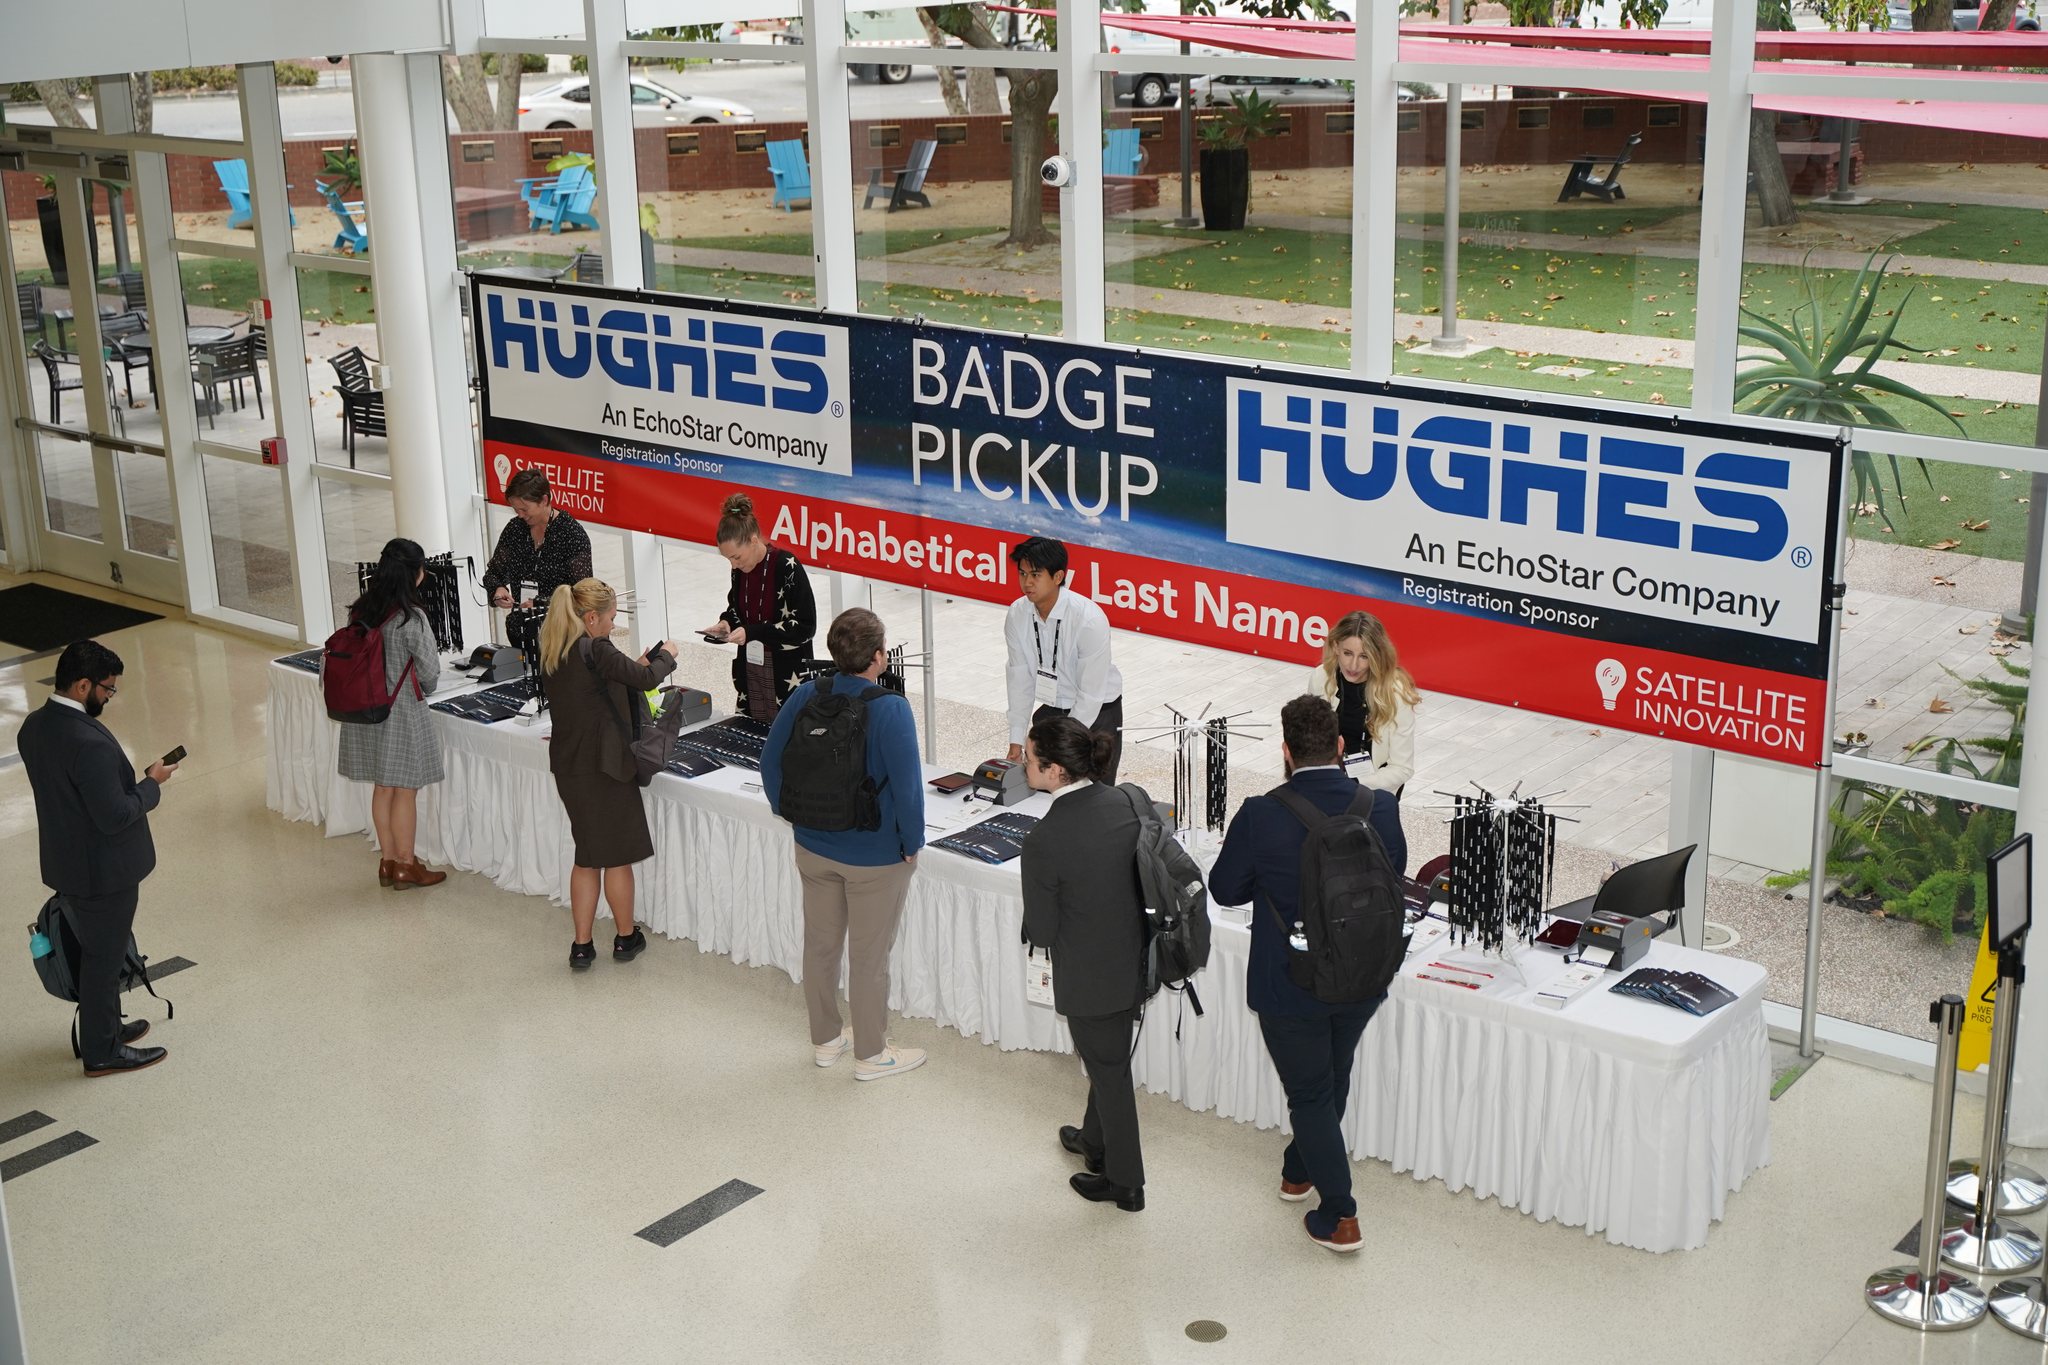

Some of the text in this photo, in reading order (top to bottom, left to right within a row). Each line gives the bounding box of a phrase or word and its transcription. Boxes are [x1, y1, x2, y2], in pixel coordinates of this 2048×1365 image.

[487, 294, 829, 414] HUGHES
[912, 338, 1155, 438] BADGE
[601, 402, 828, 465] An EchoStar Company
[601, 440, 723, 474] Registration Sponsor
[911, 422, 1159, 522] PICKUP
[1237, 389, 1790, 562] HUGHES
[770, 504, 1329, 648] Alphabetical Last Name
[1402, 578, 1599, 630] Registration Sponsor
[1405, 533, 1781, 628] An EchoStar Company
[1634, 698, 1806, 752] INNOVATION
[1635, 666, 1807, 725] SATELLITE
[1971, 1013, 1992, 1024] PISO
